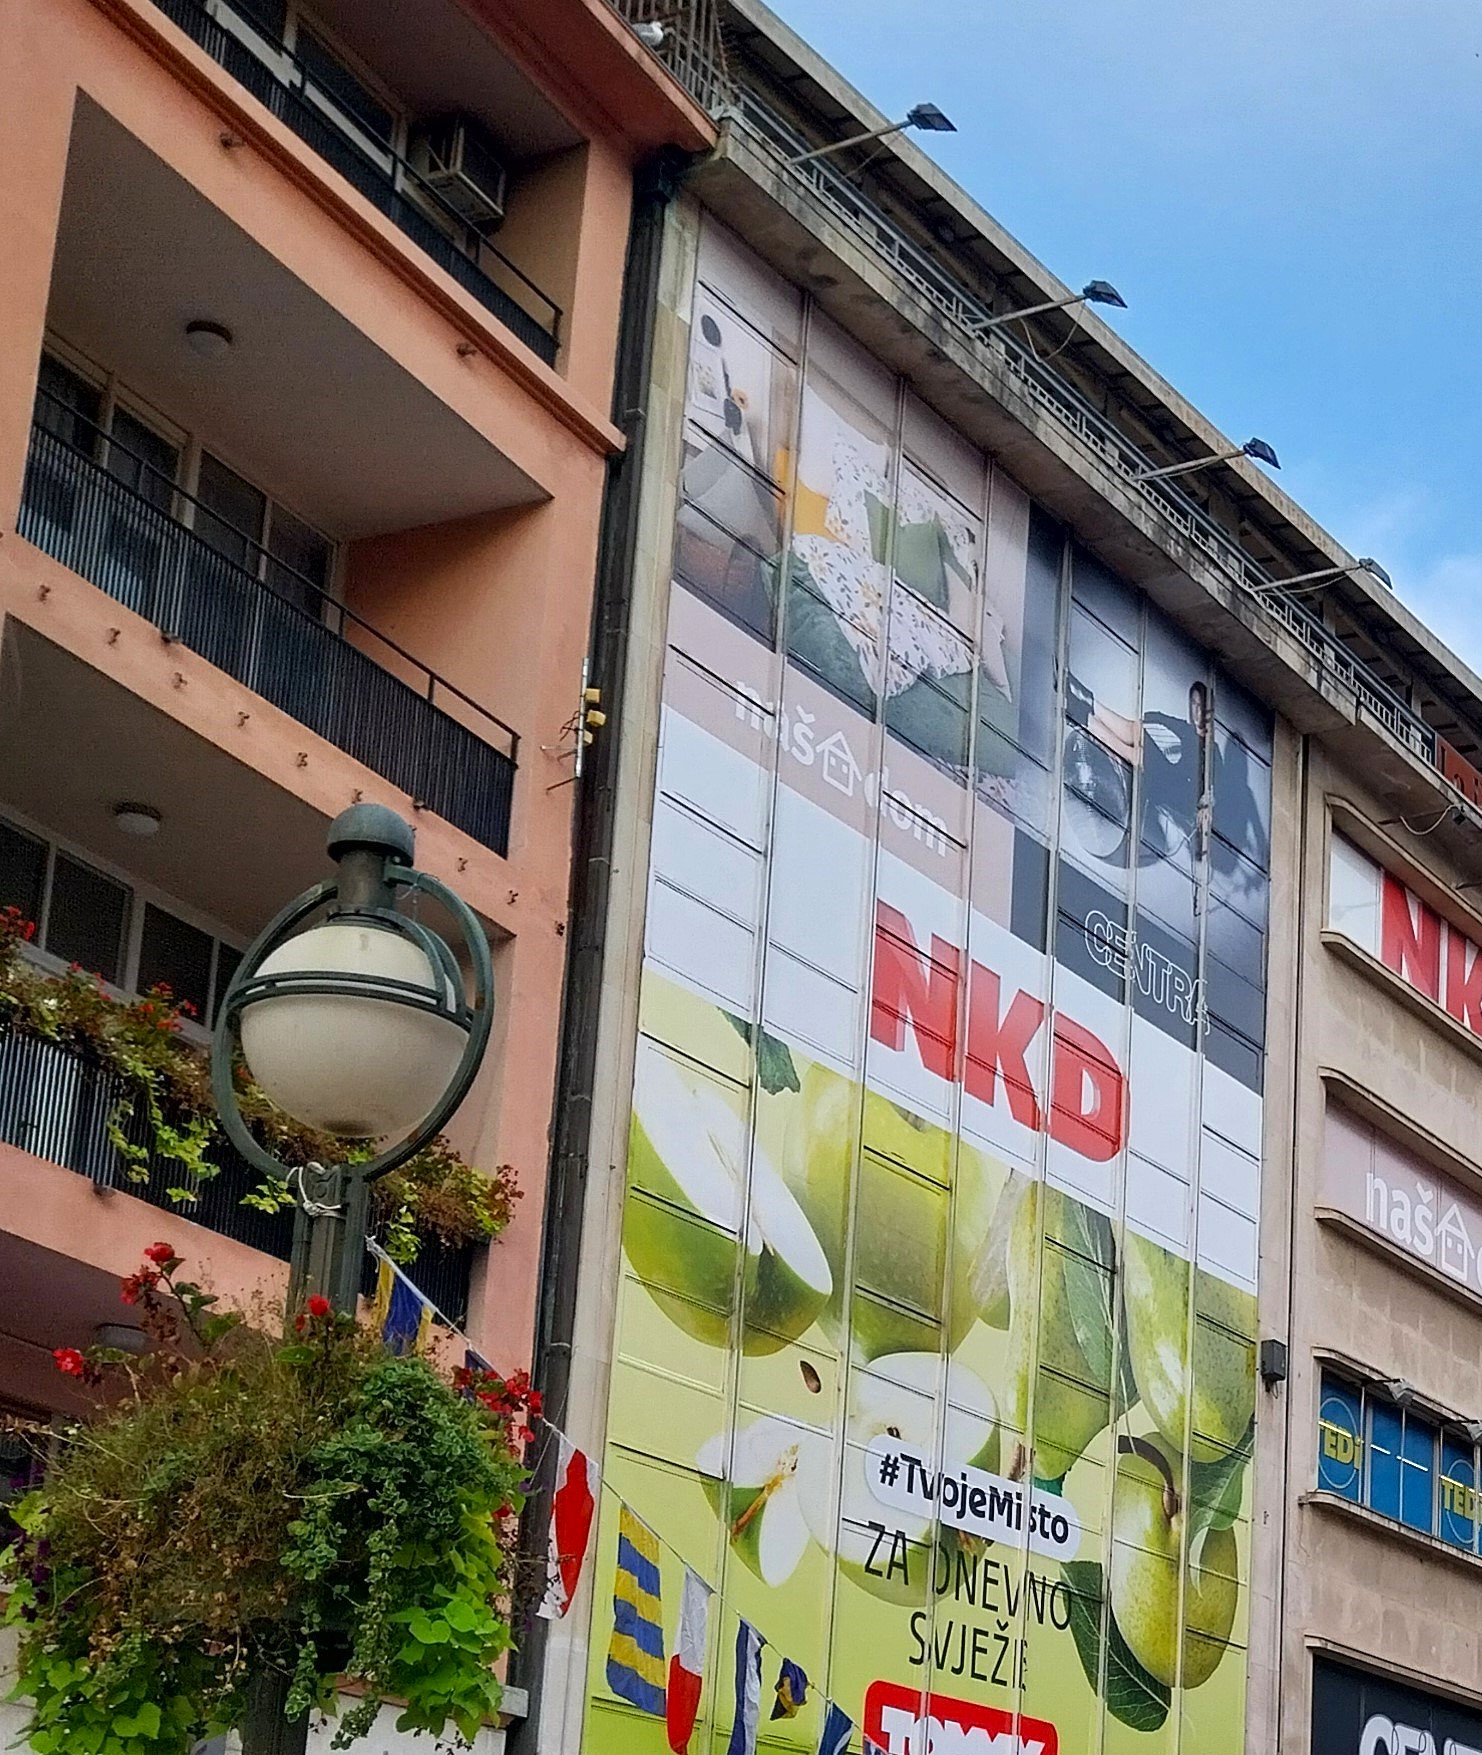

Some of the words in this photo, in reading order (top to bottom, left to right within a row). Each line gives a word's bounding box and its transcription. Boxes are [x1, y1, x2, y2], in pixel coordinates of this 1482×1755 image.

[1084, 909, 1211, 1036] CENTRA
[871, 898, 1131, 1162] NKD
[1366, 1172, 1434, 1256] naš
[879, 1450, 1071, 1546] #TvojeMisto
[864, 1520, 910, 1587] ZA
[934, 1552, 1074, 1632] DNEVNO
